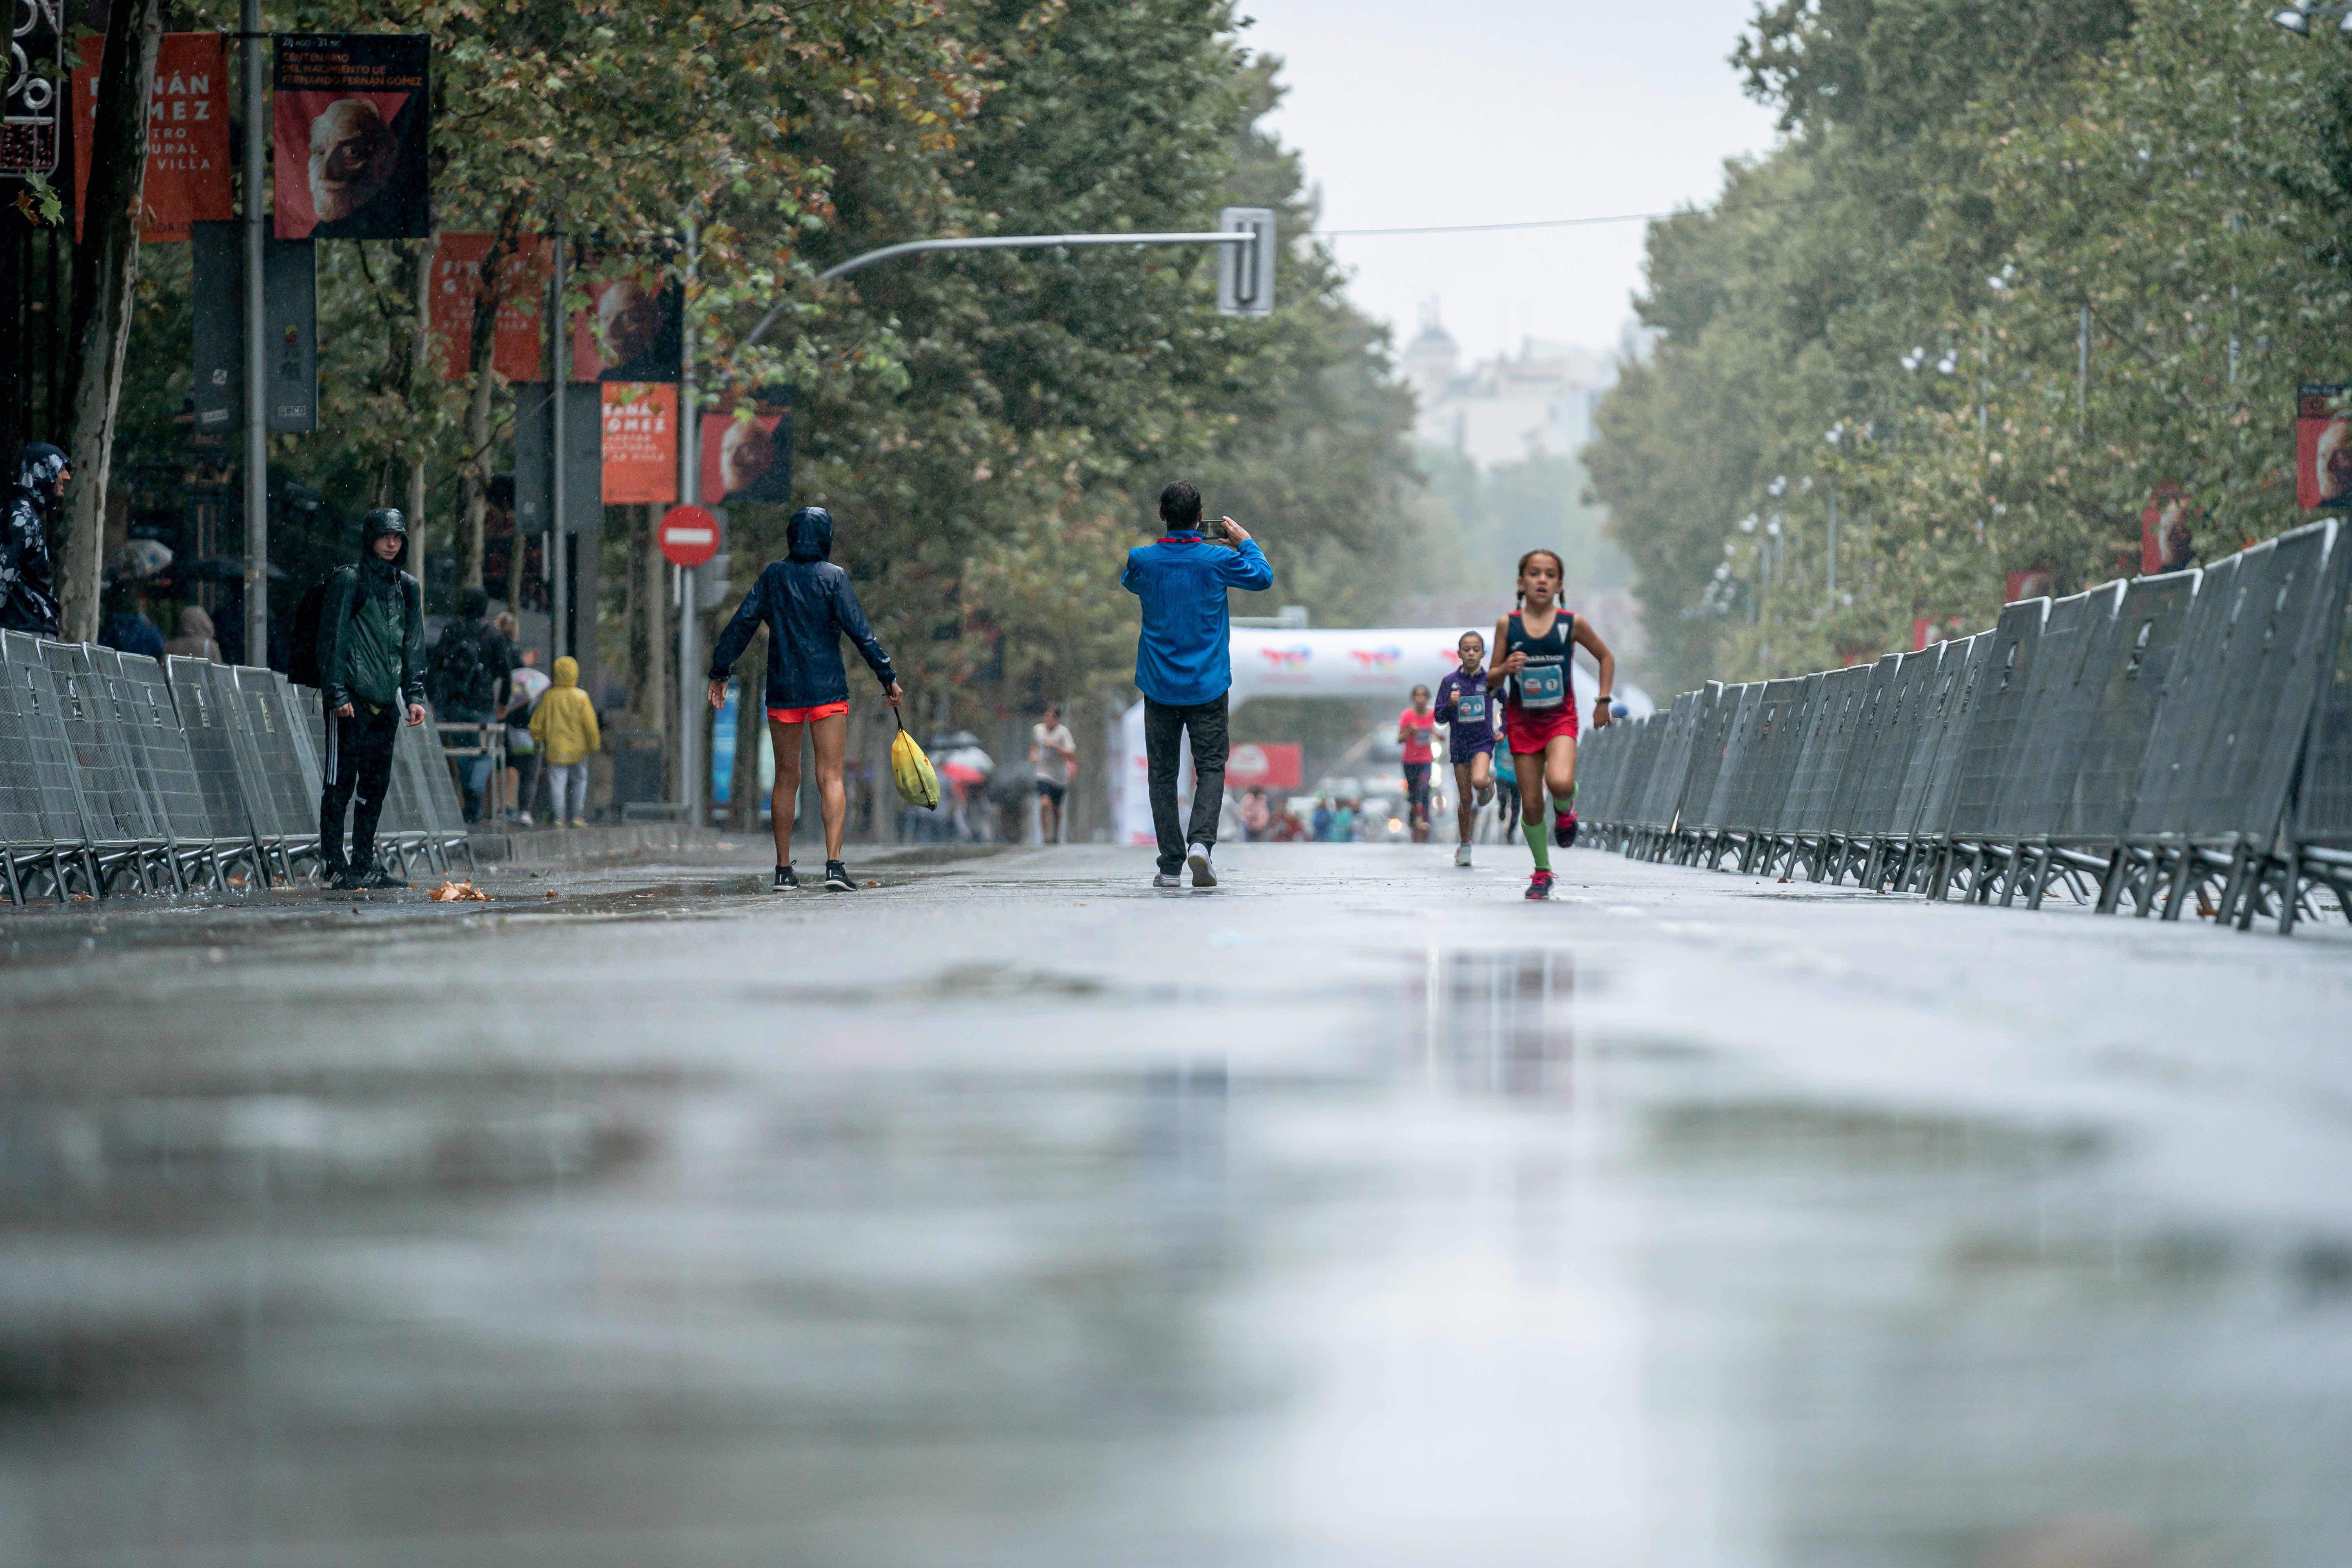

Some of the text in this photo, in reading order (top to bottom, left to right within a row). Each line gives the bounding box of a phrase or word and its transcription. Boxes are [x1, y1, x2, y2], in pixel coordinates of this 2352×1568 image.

[318, 37, 328, 47] 31
[282, 53, 350, 62] CENTENARIO
[372, 65, 386, 74] DE
[157, 158, 211, 170] VILLA
